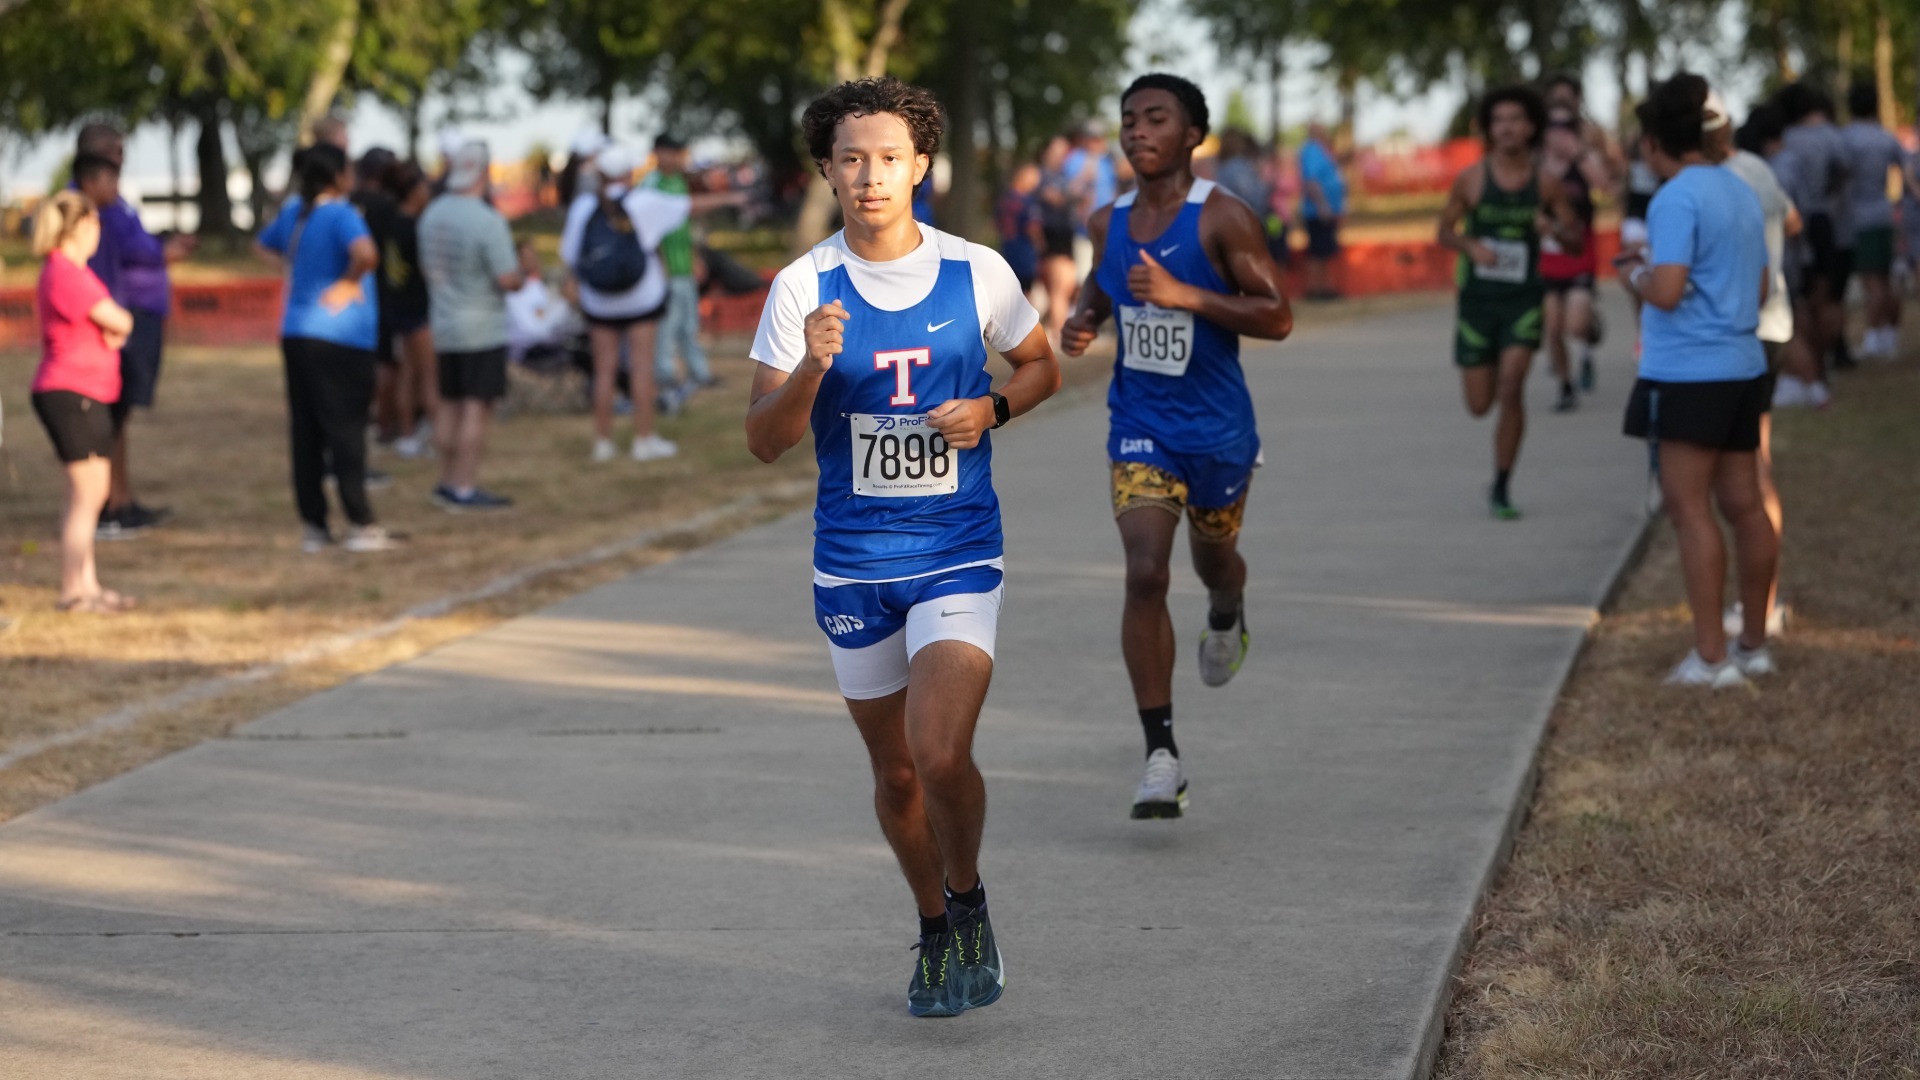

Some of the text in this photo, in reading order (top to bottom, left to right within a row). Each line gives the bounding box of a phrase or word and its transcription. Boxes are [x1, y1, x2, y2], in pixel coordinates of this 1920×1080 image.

[1125, 322, 1186, 361] 7895
[874, 347, 931, 407] T
[899, 416, 930, 426] ProF
[859, 431, 950, 480] 7898
[824, 614, 864, 635] CATS
